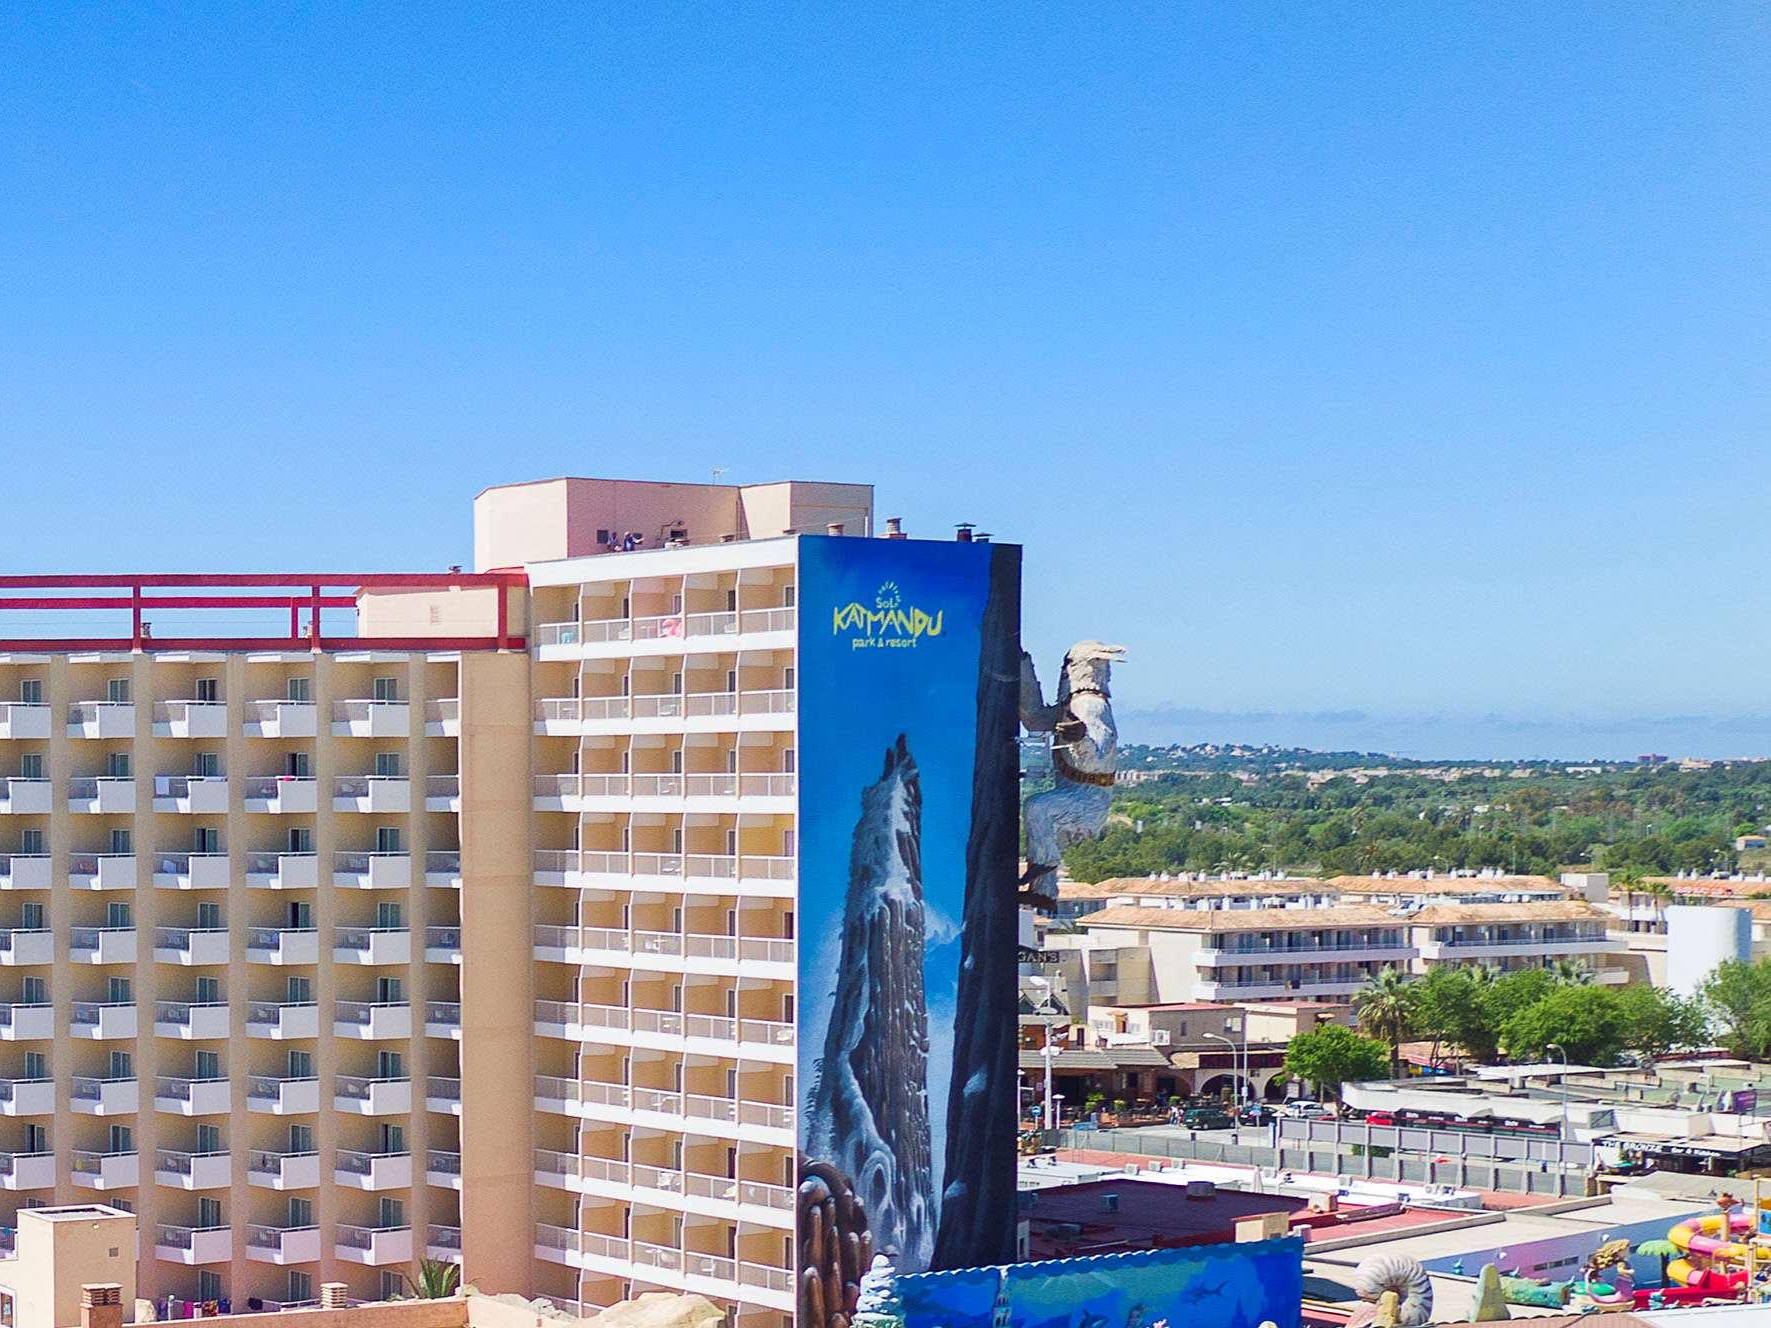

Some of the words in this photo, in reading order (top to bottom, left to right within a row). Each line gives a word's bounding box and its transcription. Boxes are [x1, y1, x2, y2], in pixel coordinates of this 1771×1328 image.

[833, 602, 943, 637] KATMANDU
[852, 638, 875, 651] park
[886, 638, 917, 648] resort
